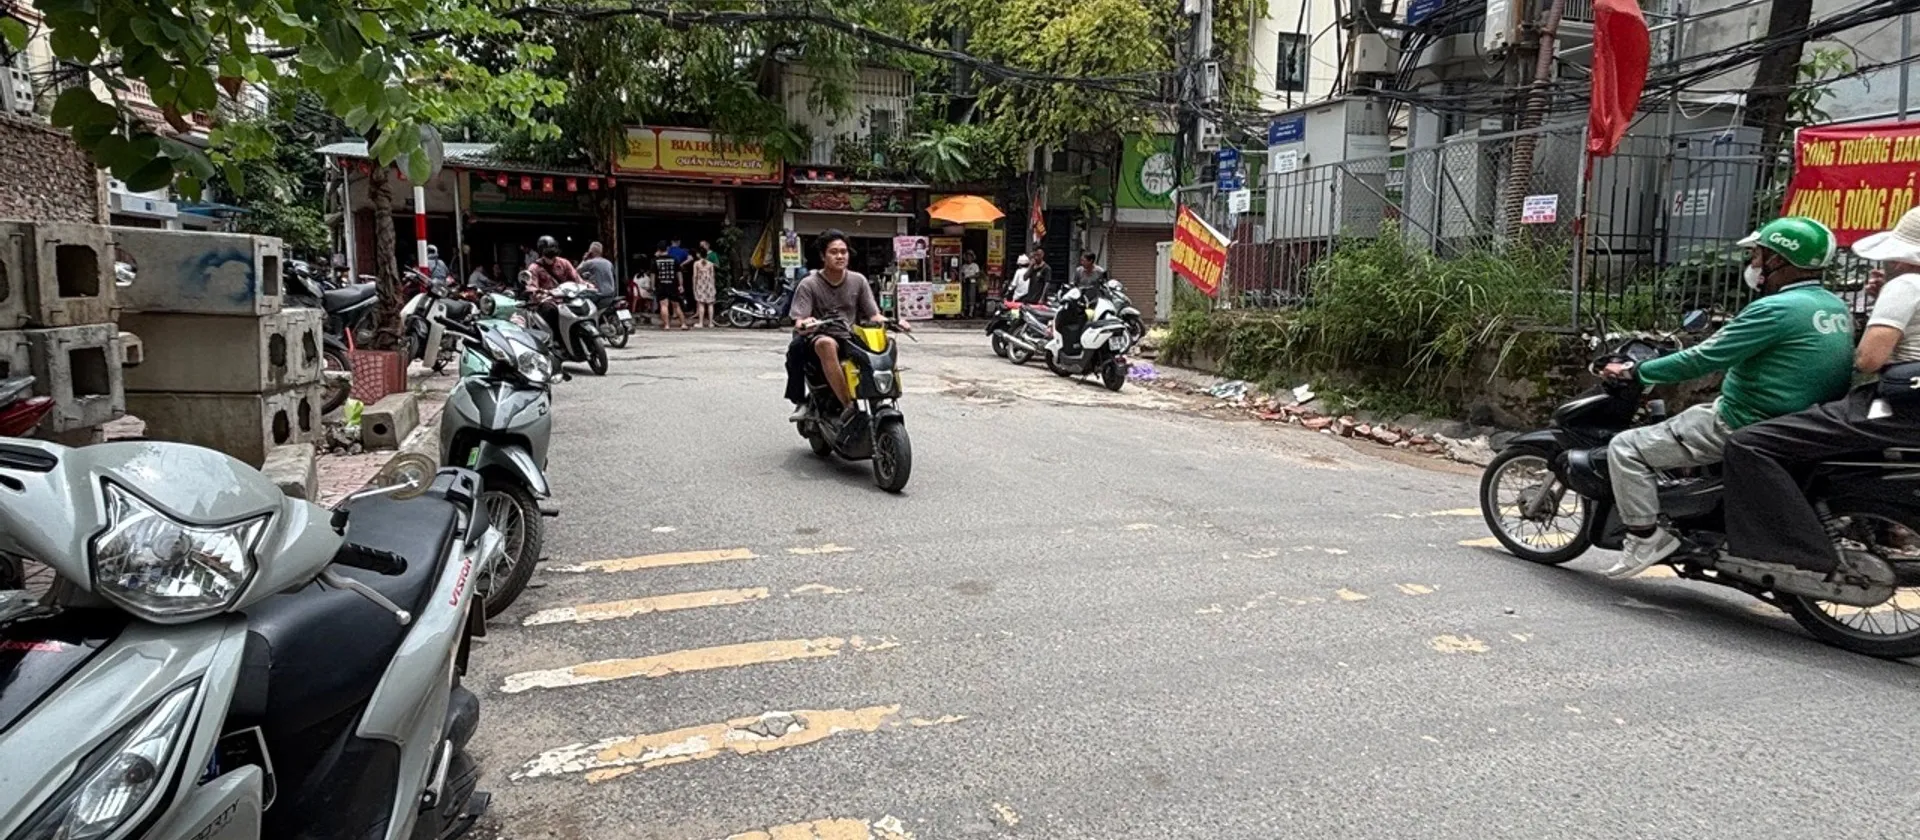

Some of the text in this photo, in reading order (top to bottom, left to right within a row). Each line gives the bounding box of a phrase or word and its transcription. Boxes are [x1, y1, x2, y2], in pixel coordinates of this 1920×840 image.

[1802, 136, 1836, 166] CÔNG
[1838, 133, 1890, 165] TRƯỜNG
[1787, 181, 1841, 229] KHÔNG
[1842, 181, 1888, 230] DỪNG
[1769, 232, 1800, 251] Grab
[1813, 310, 1849, 334] Gra
[449, 556, 472, 606] VISION
